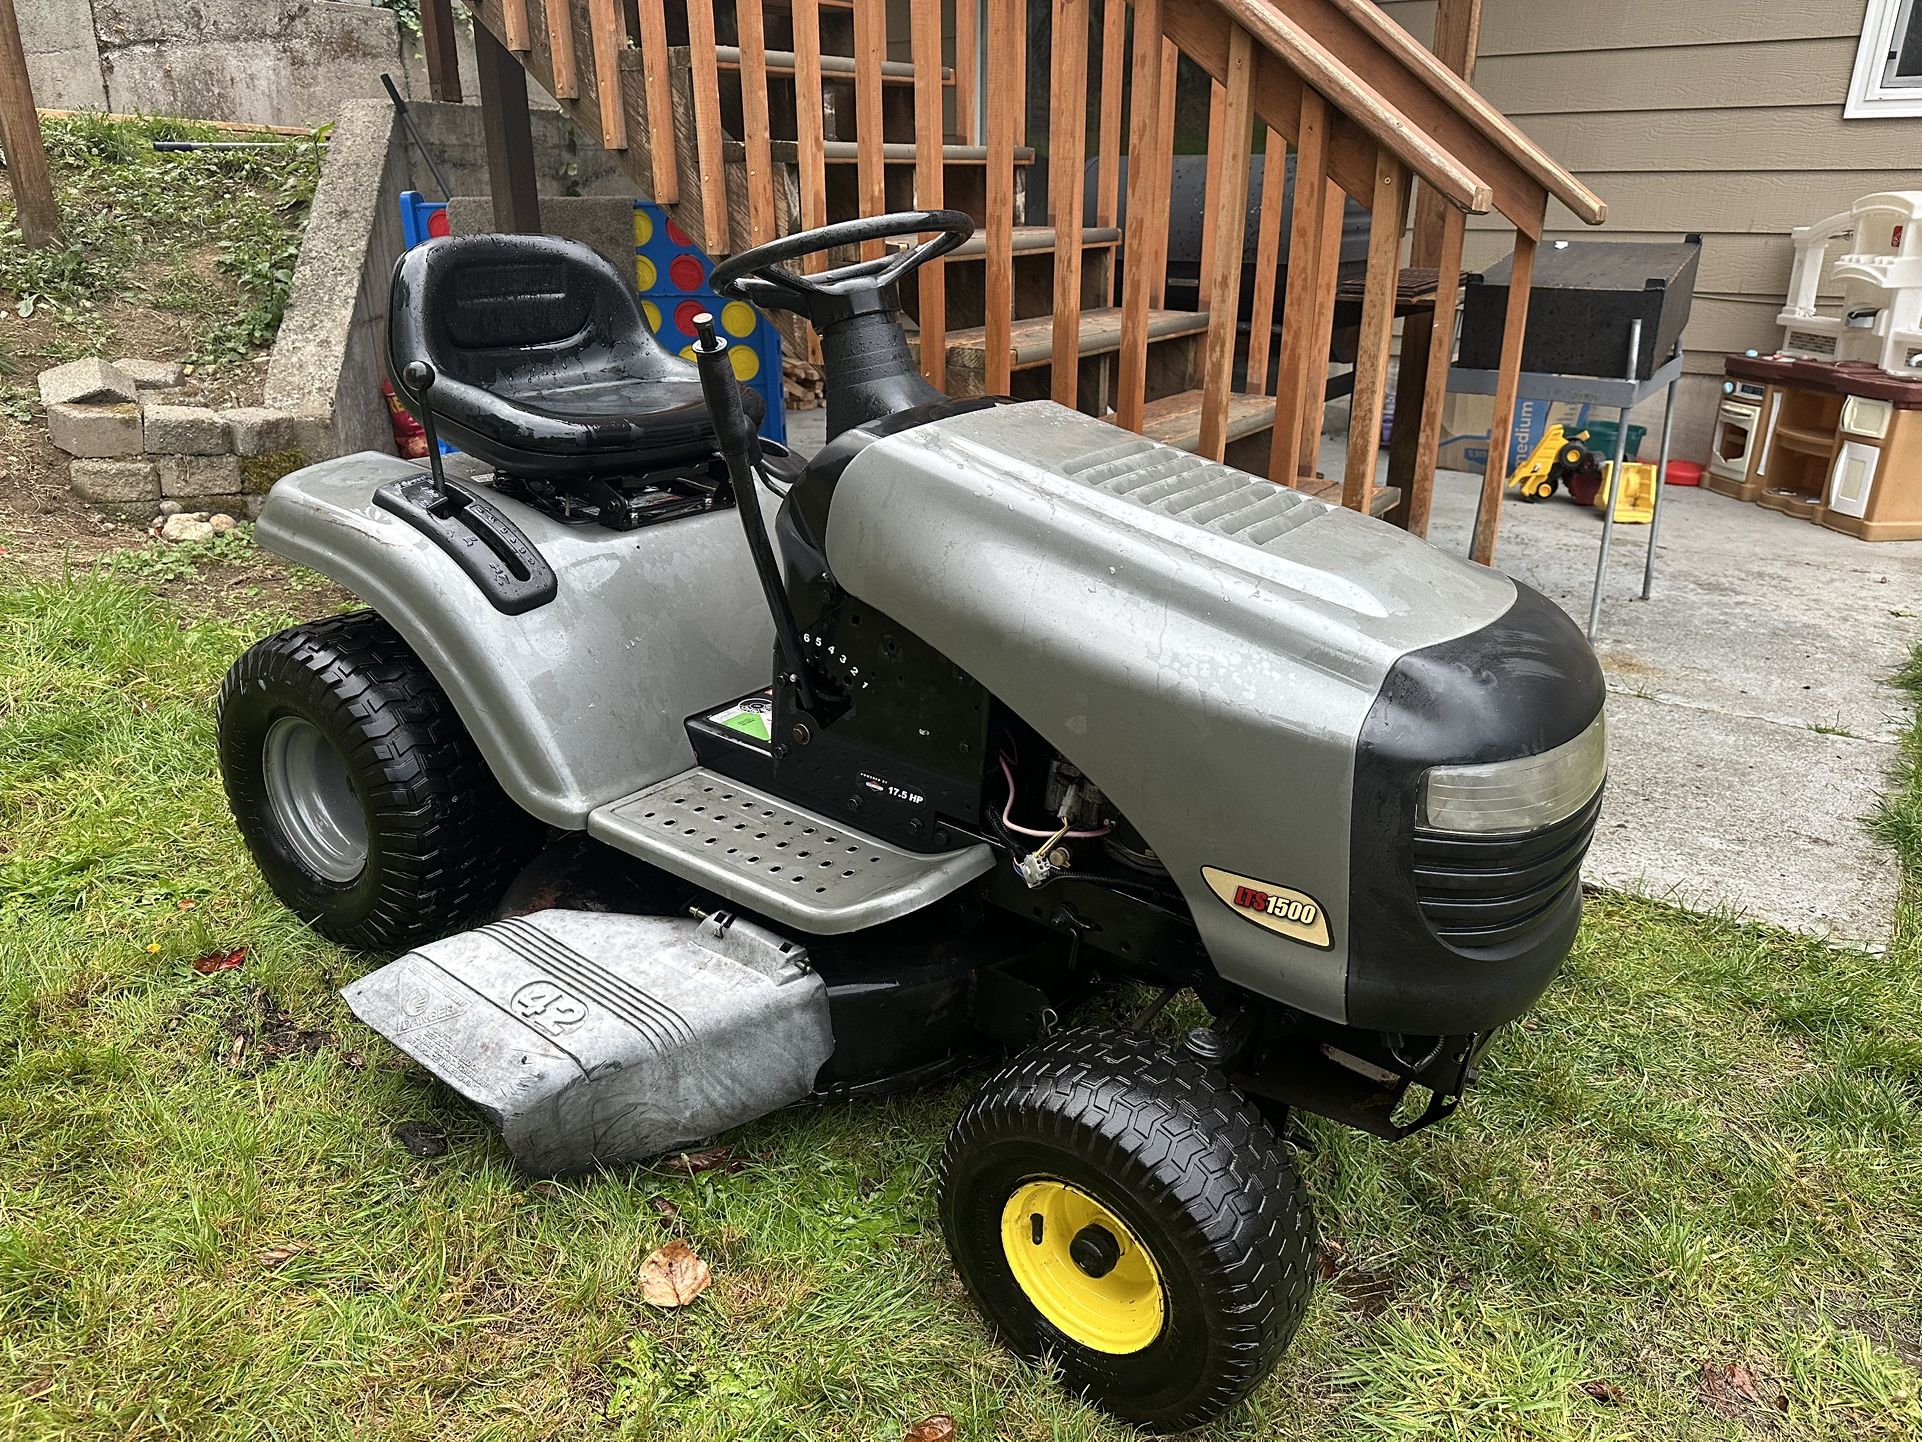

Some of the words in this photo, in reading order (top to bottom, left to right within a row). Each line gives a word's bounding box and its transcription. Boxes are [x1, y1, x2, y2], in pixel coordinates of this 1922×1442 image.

[803, 633, 810, 643] 6
[815, 637, 822, 646] 5
[828, 645, 835, 654] 4
[839, 654, 847, 664] 3
[850, 666, 859, 677] 2
[862, 681, 869, 689] 1
[888, 786, 908, 800] 17.5
[908, 793, 924, 804] HP
[1233, 885, 1318, 925] LTS1500
[400, 1005, 455, 1031] DANGER
[517, 990, 586, 1037] 42
